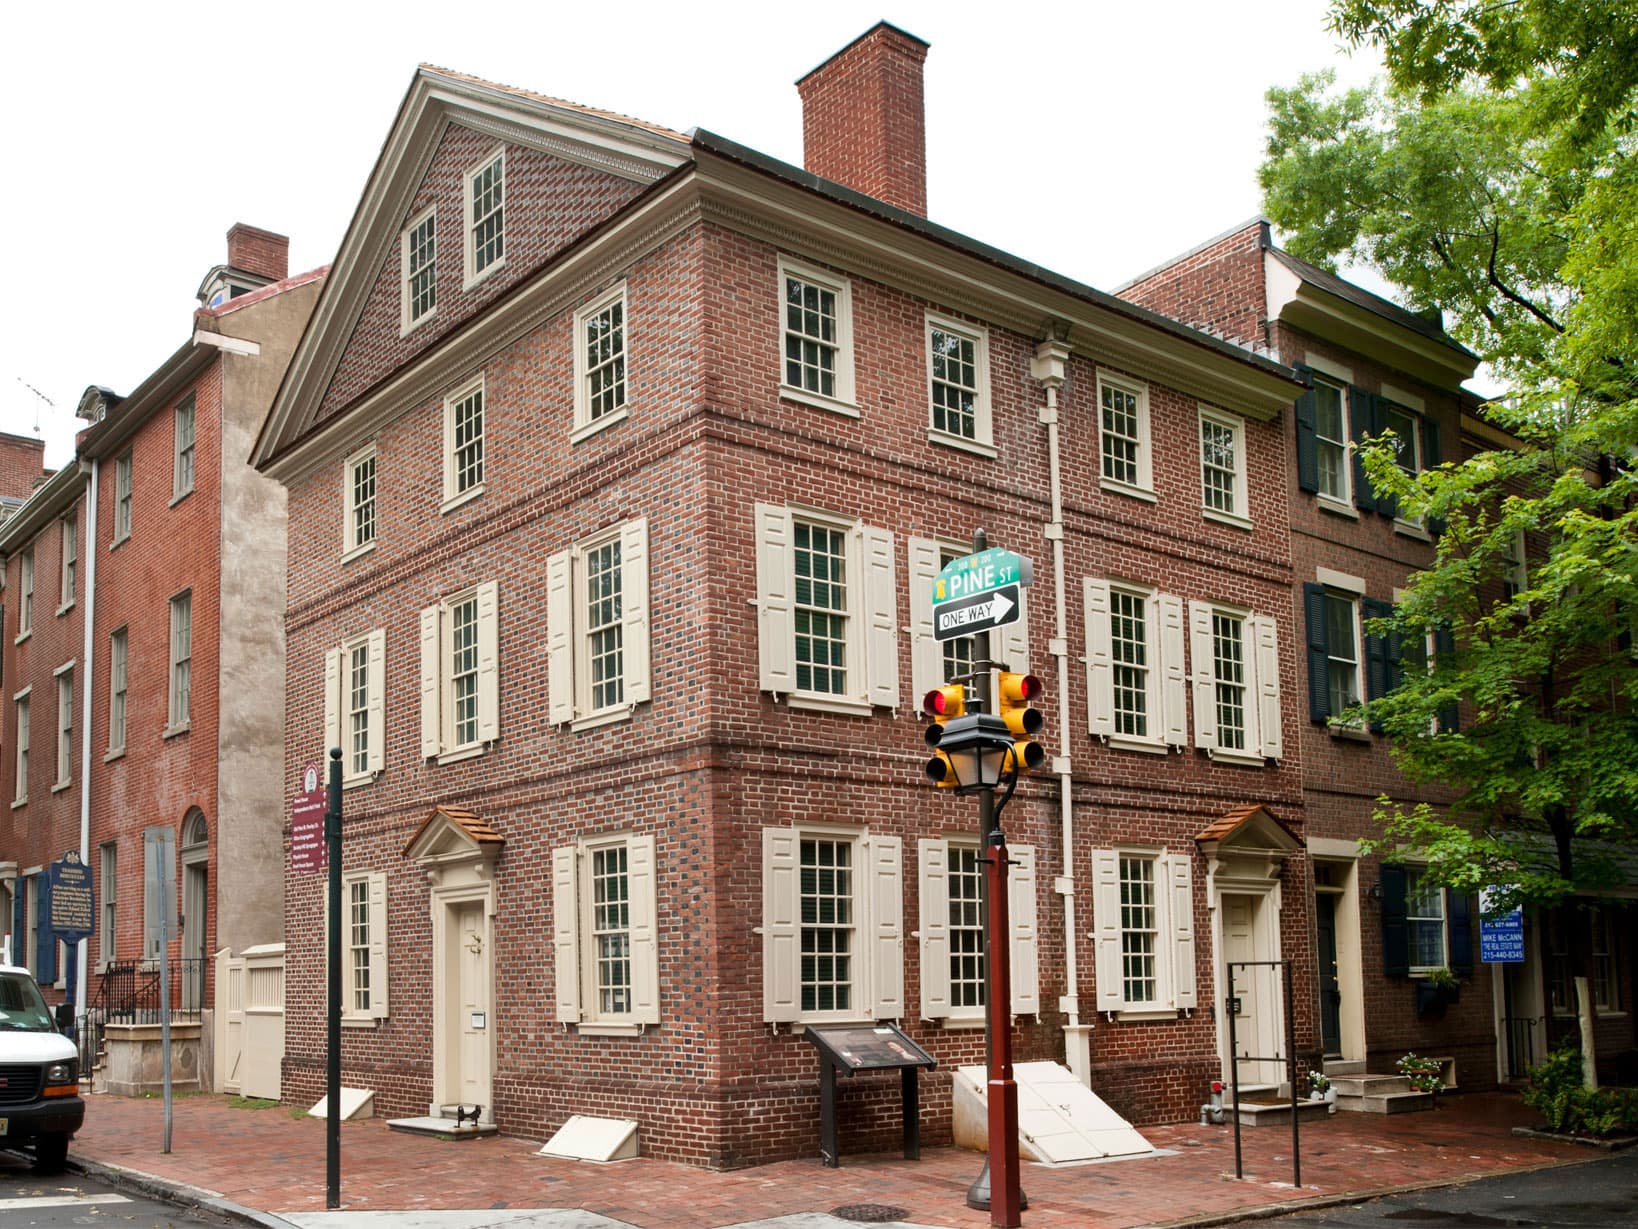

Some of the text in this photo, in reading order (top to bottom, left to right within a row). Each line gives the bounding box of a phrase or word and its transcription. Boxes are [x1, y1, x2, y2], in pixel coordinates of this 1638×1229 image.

[951, 564, 1013, 597] PINE ST
[942, 602, 993, 628] ONE WAY
[1482, 932, 1522, 942] MIKE McCANN
